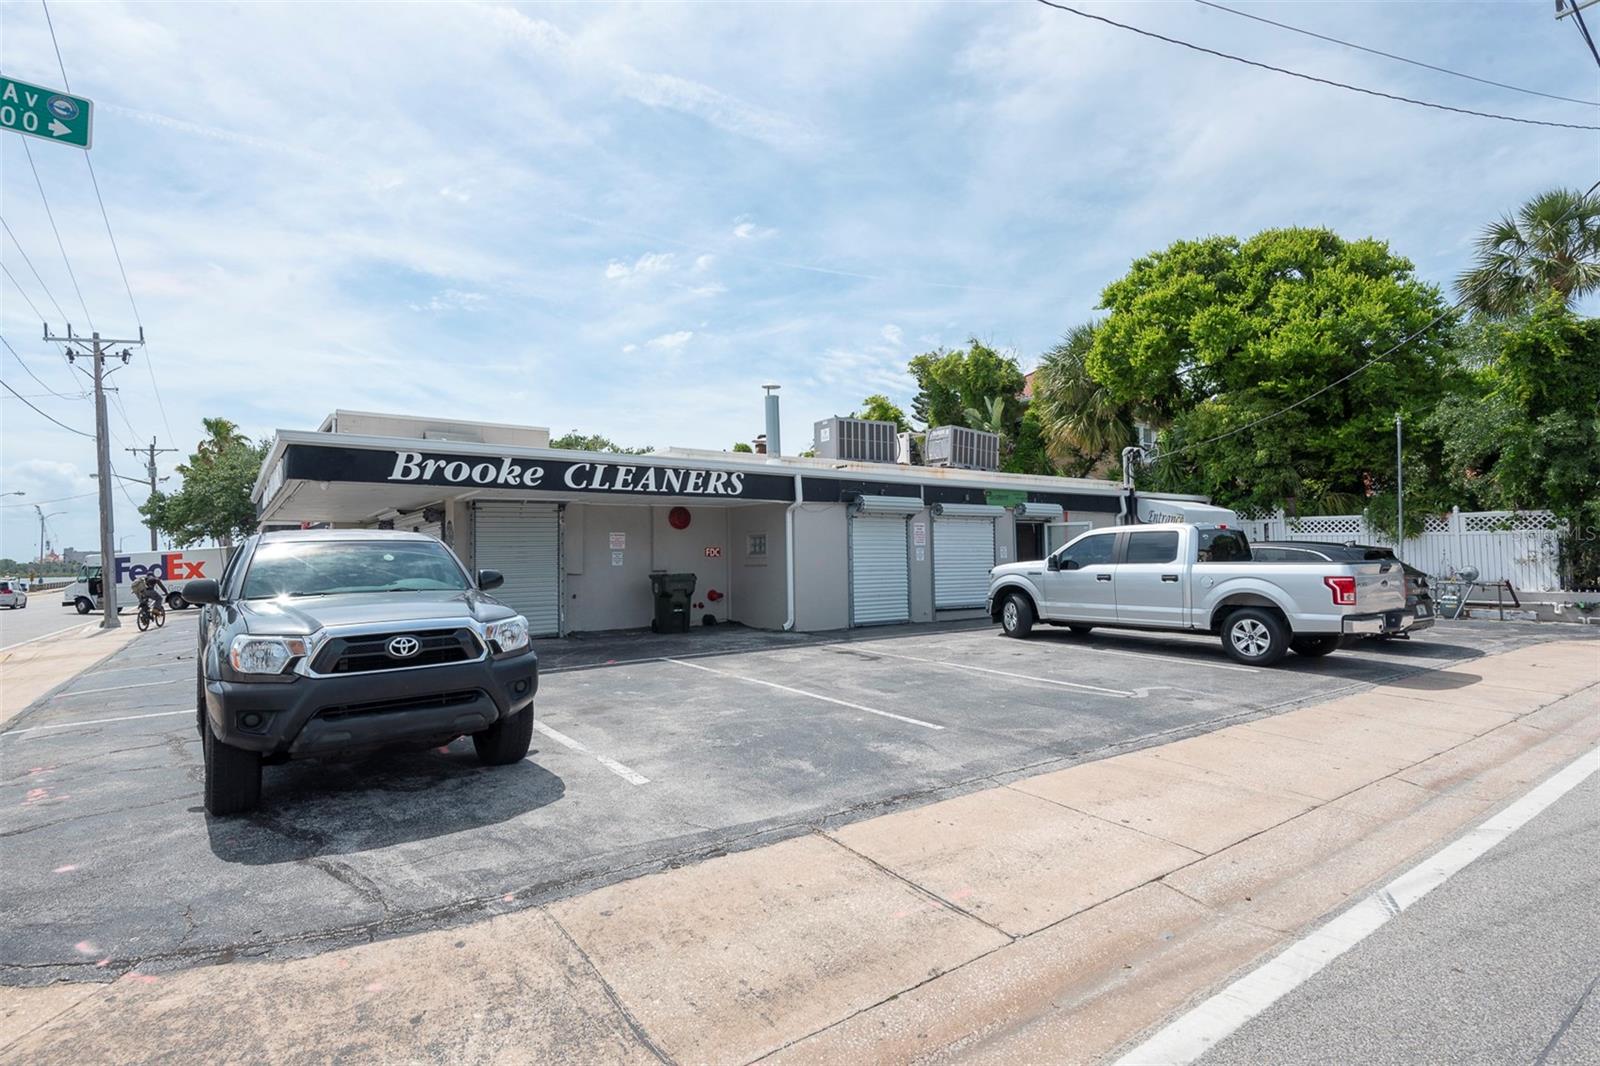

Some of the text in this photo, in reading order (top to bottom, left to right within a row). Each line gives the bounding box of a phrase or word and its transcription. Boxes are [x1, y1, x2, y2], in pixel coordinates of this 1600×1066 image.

[388, 451, 745, 497] Brooke CLEANERS
[1147, 510, 1185, 524] Entrance
[706, 548, 720, 557] FDC
[115, 553, 206, 583] FedEx
